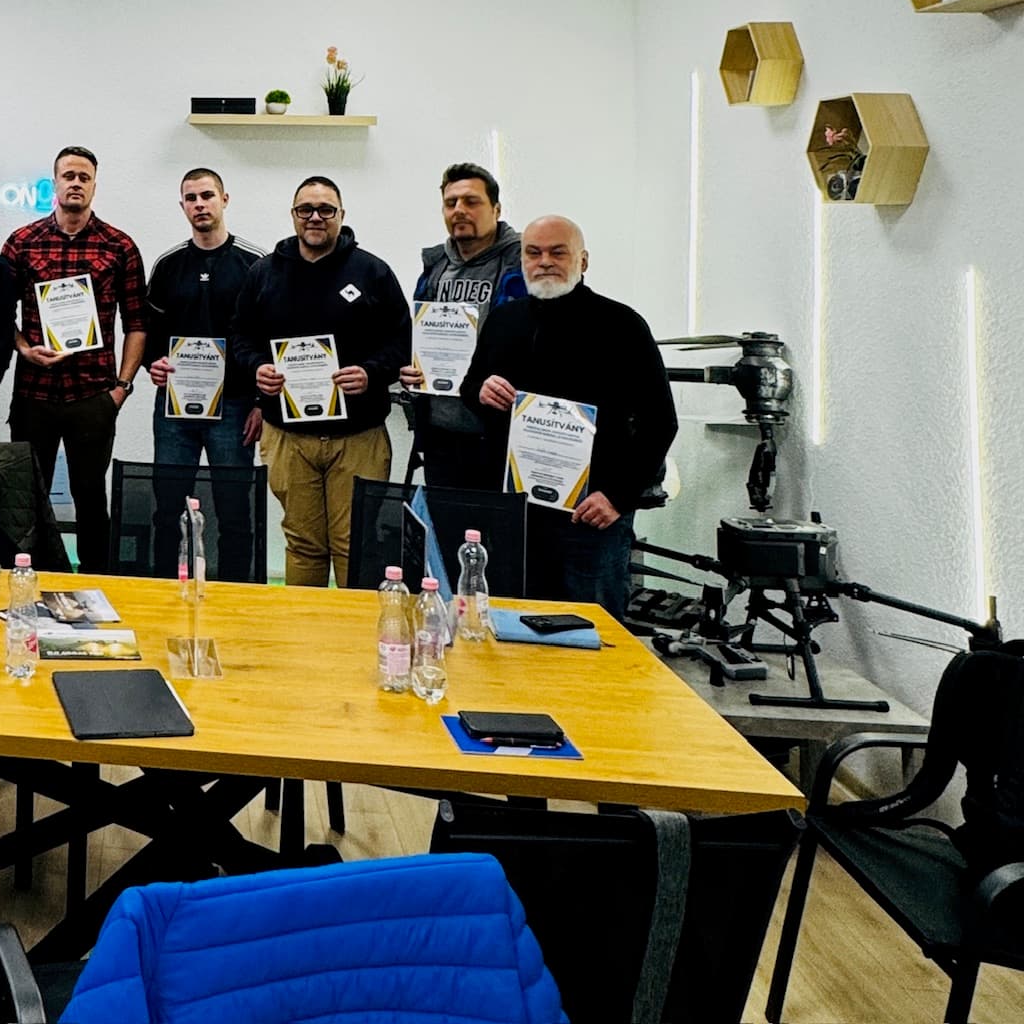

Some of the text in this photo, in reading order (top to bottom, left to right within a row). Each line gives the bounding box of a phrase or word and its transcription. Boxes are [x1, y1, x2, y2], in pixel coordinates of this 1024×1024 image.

[452, 279, 493, 304] DIEG
[421, 320, 470, 329] TANUSÍTVÁNY
[521, 414, 585, 434] TANUSÍTVÁNY
